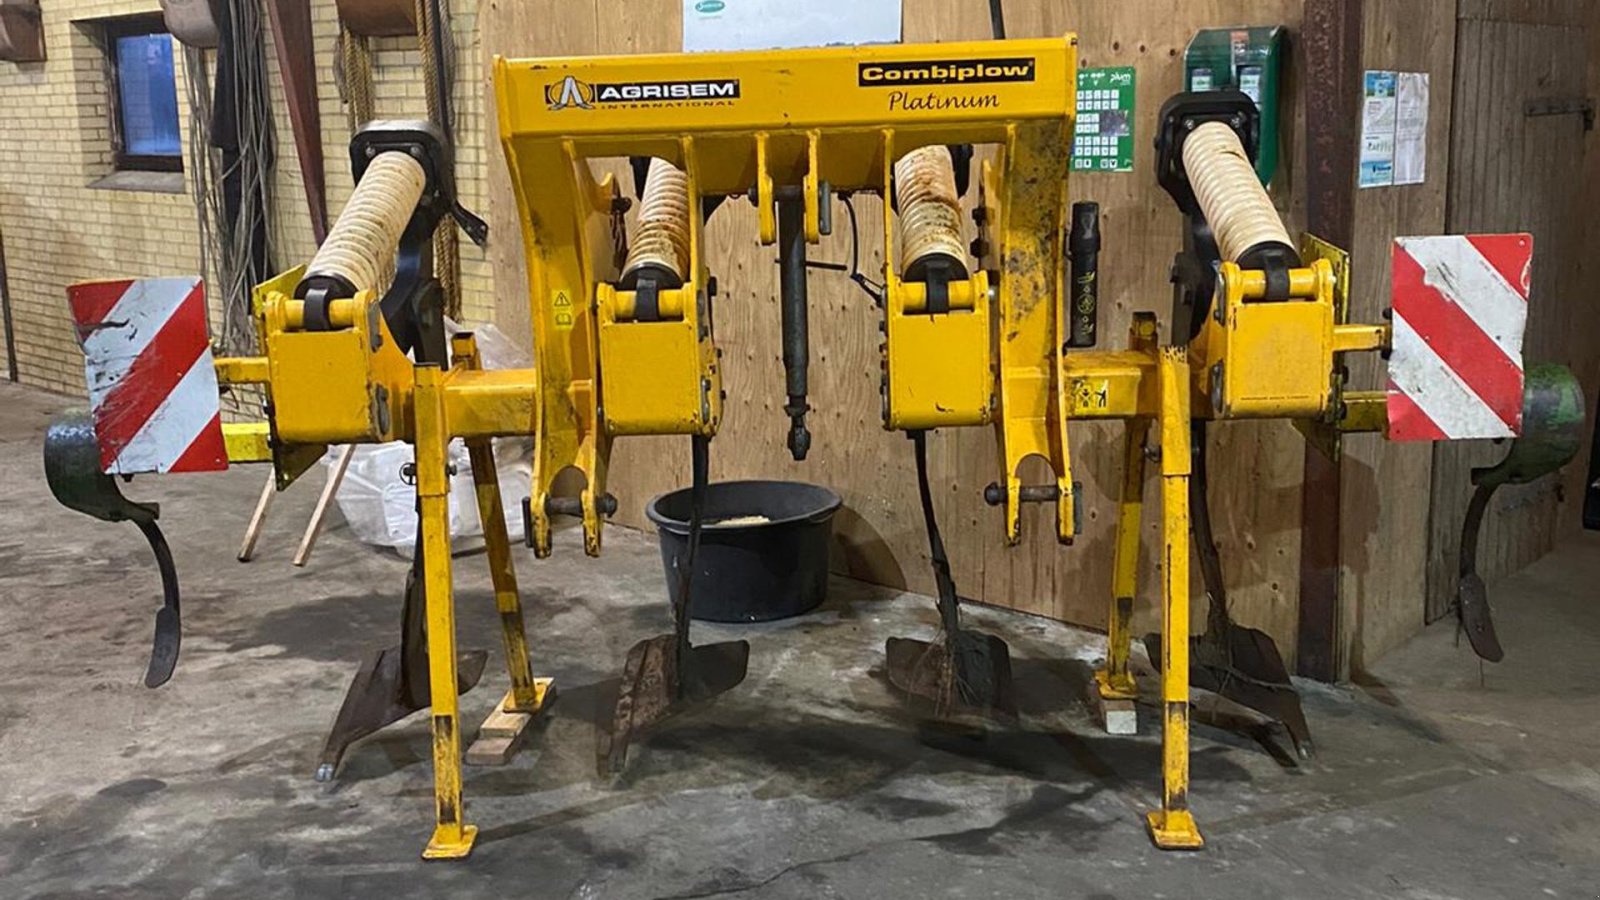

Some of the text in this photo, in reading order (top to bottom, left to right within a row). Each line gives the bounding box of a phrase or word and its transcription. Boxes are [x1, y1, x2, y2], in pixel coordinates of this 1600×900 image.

[862, 63, 1030, 81] Combiplow
[600, 82, 734, 99] AGRISEM
[601, 100, 735, 110] INTERNATIONAL
[888, 90, 999, 111] Platinum
